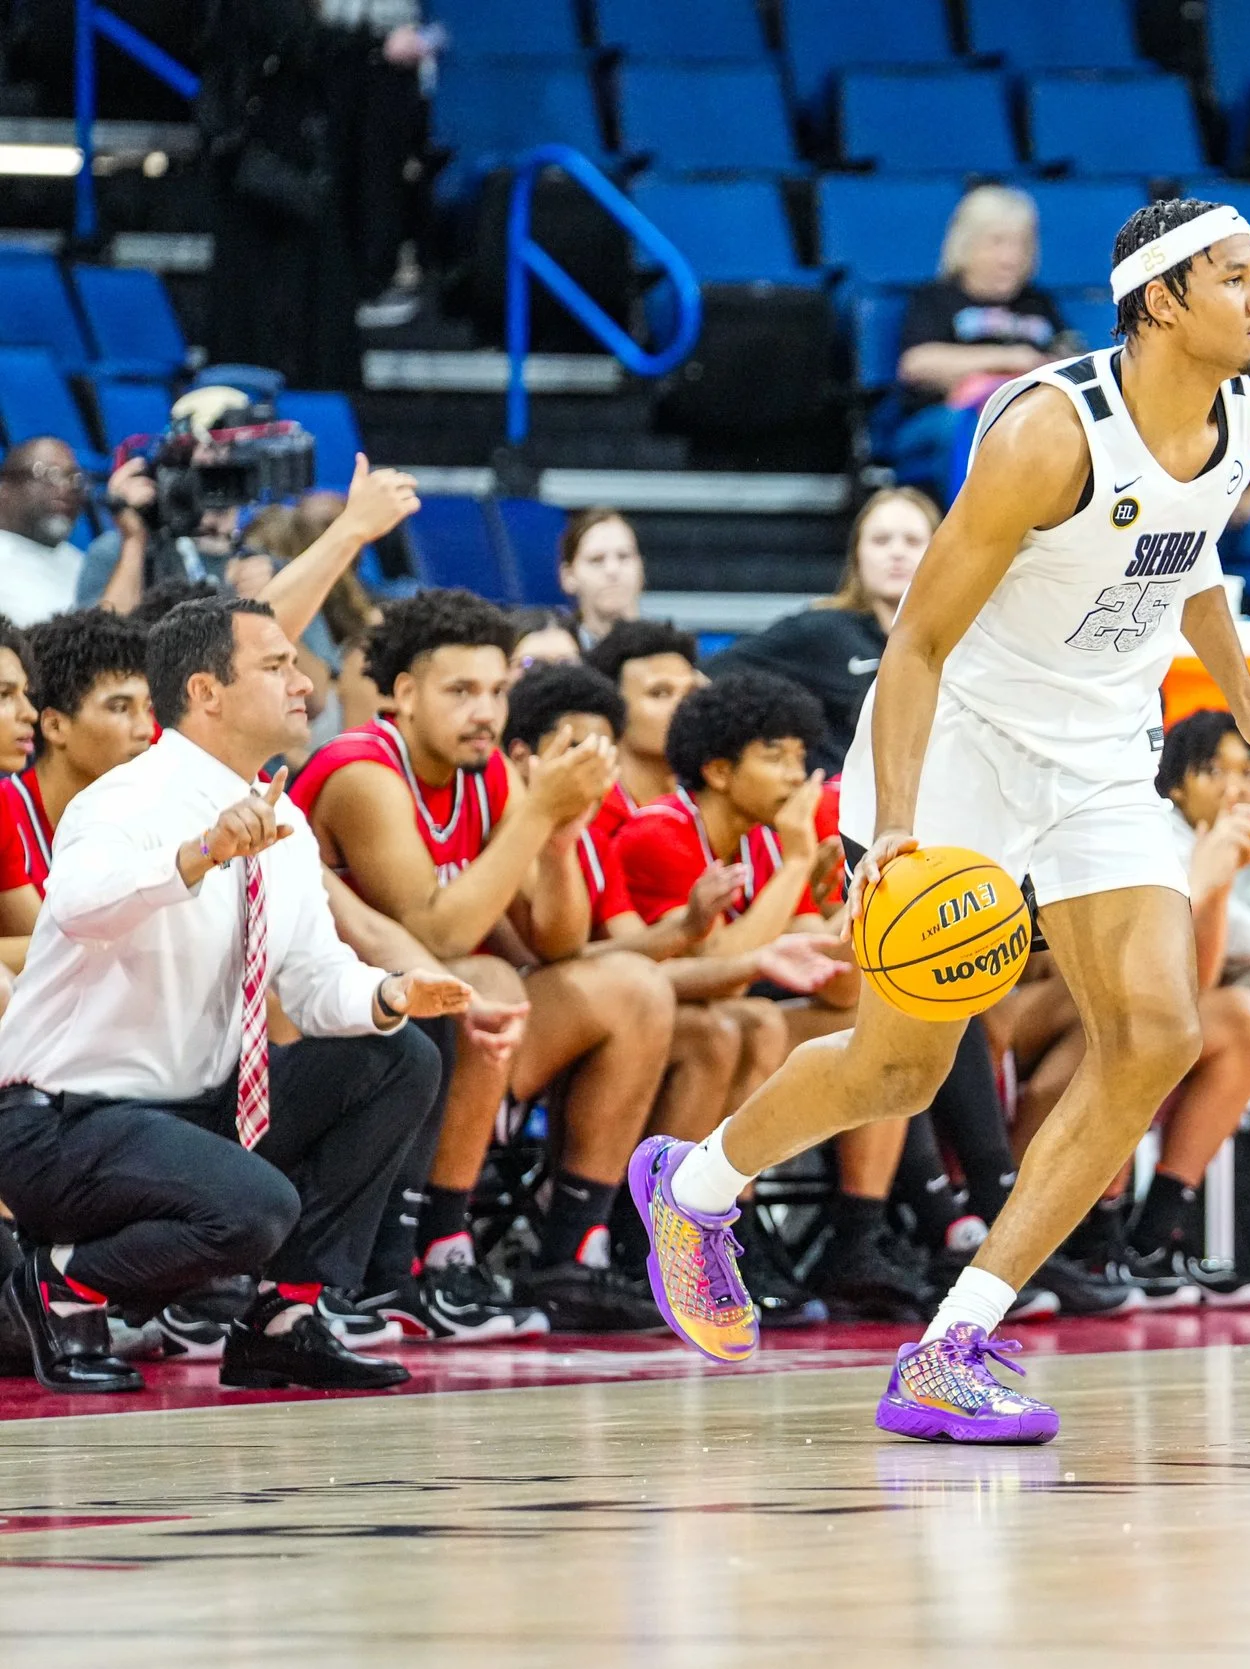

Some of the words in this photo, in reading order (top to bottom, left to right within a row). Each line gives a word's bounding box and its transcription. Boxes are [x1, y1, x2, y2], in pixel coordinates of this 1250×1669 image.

[1141, 245, 1166, 272] 25
[1115, 505, 1135, 520] HL
[1124, 530, 1208, 578] SIERRA
[1064, 579, 1182, 653] 25
[921, 923, 941, 942] NXT
[931, 922, 1029, 985] Wilson
